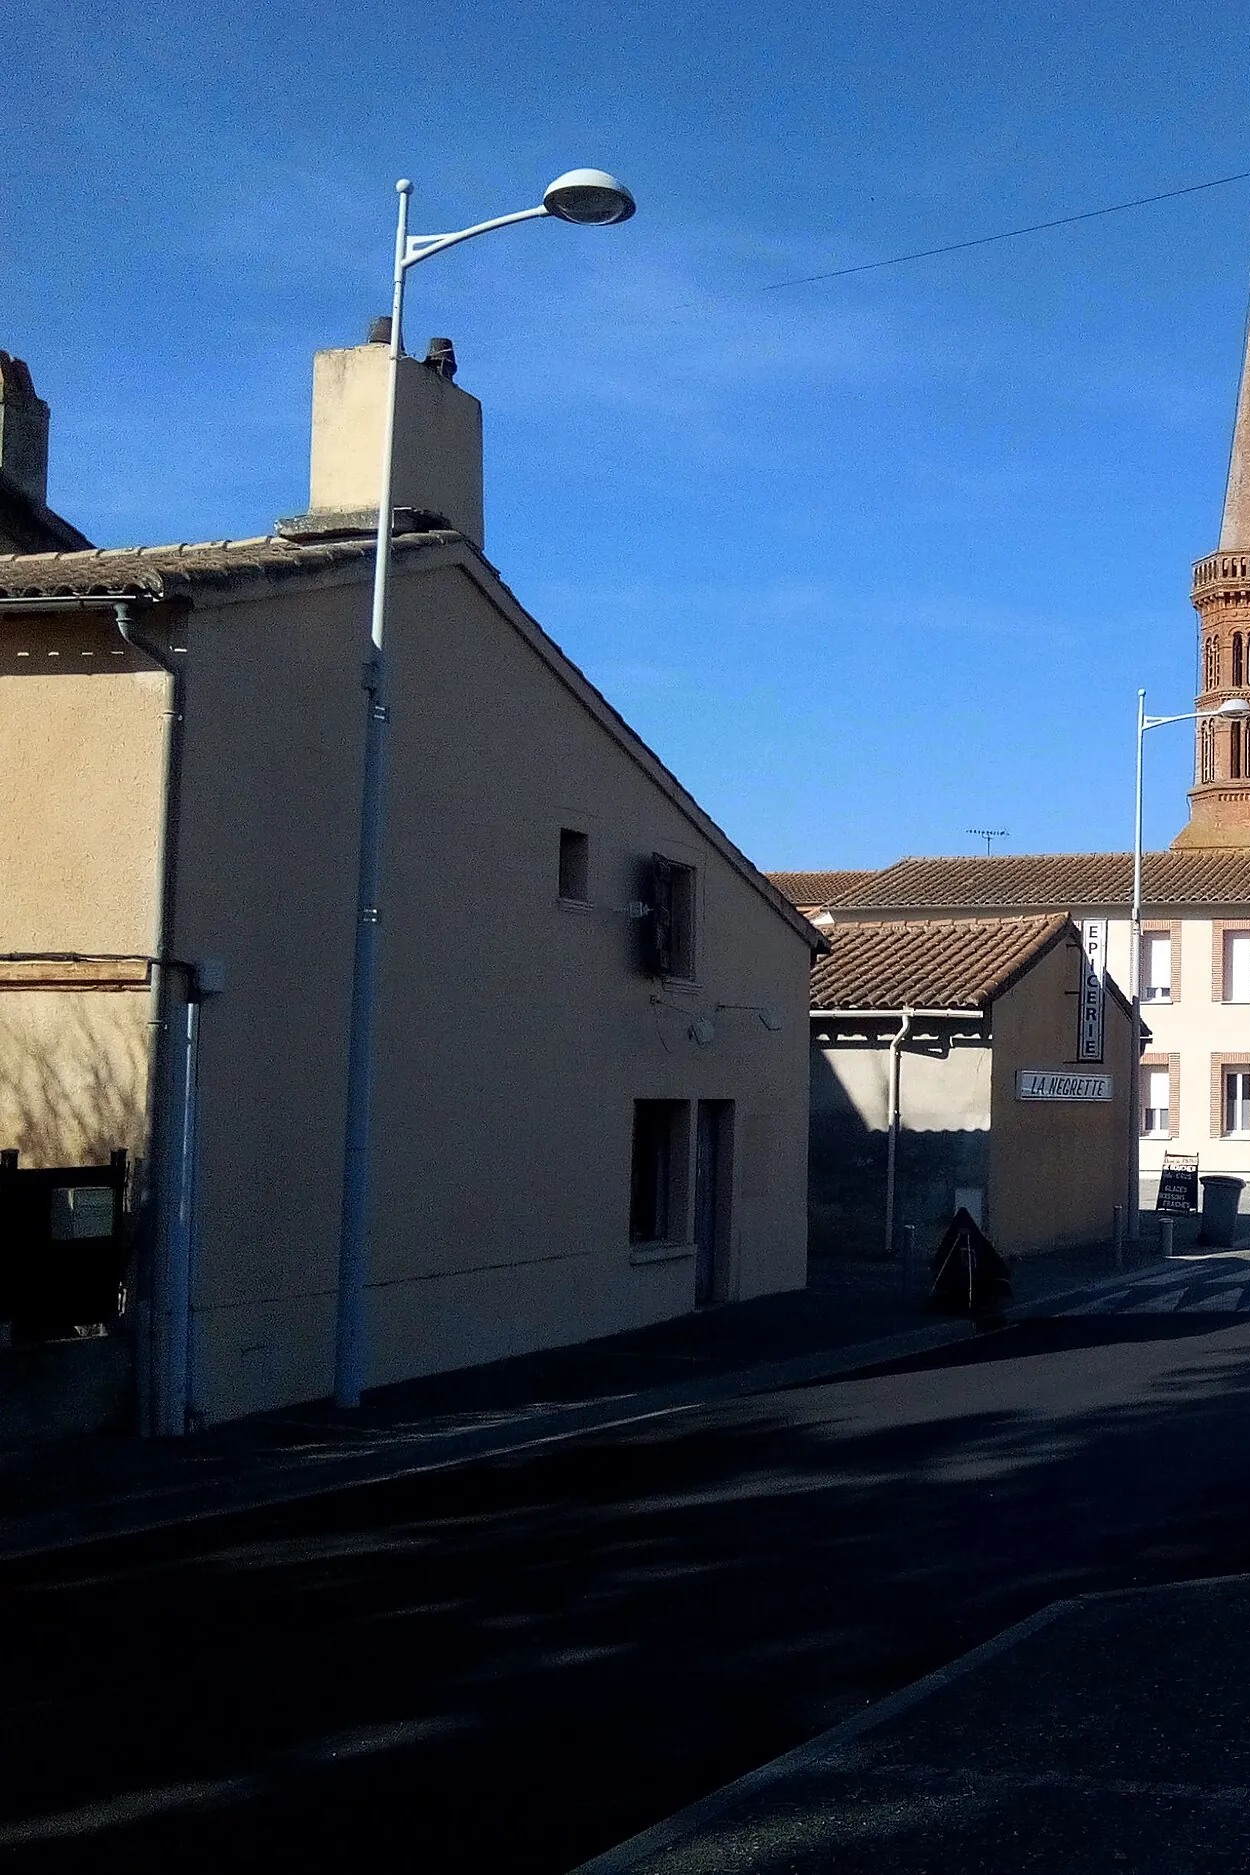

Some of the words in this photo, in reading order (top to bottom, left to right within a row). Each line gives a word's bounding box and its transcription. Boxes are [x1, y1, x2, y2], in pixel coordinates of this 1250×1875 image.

[1085, 925, 1099, 1054] EPICERIE
[1031, 1076, 1046, 1095] LA
[1049, 1077, 1105, 1096] NEGRETTE
